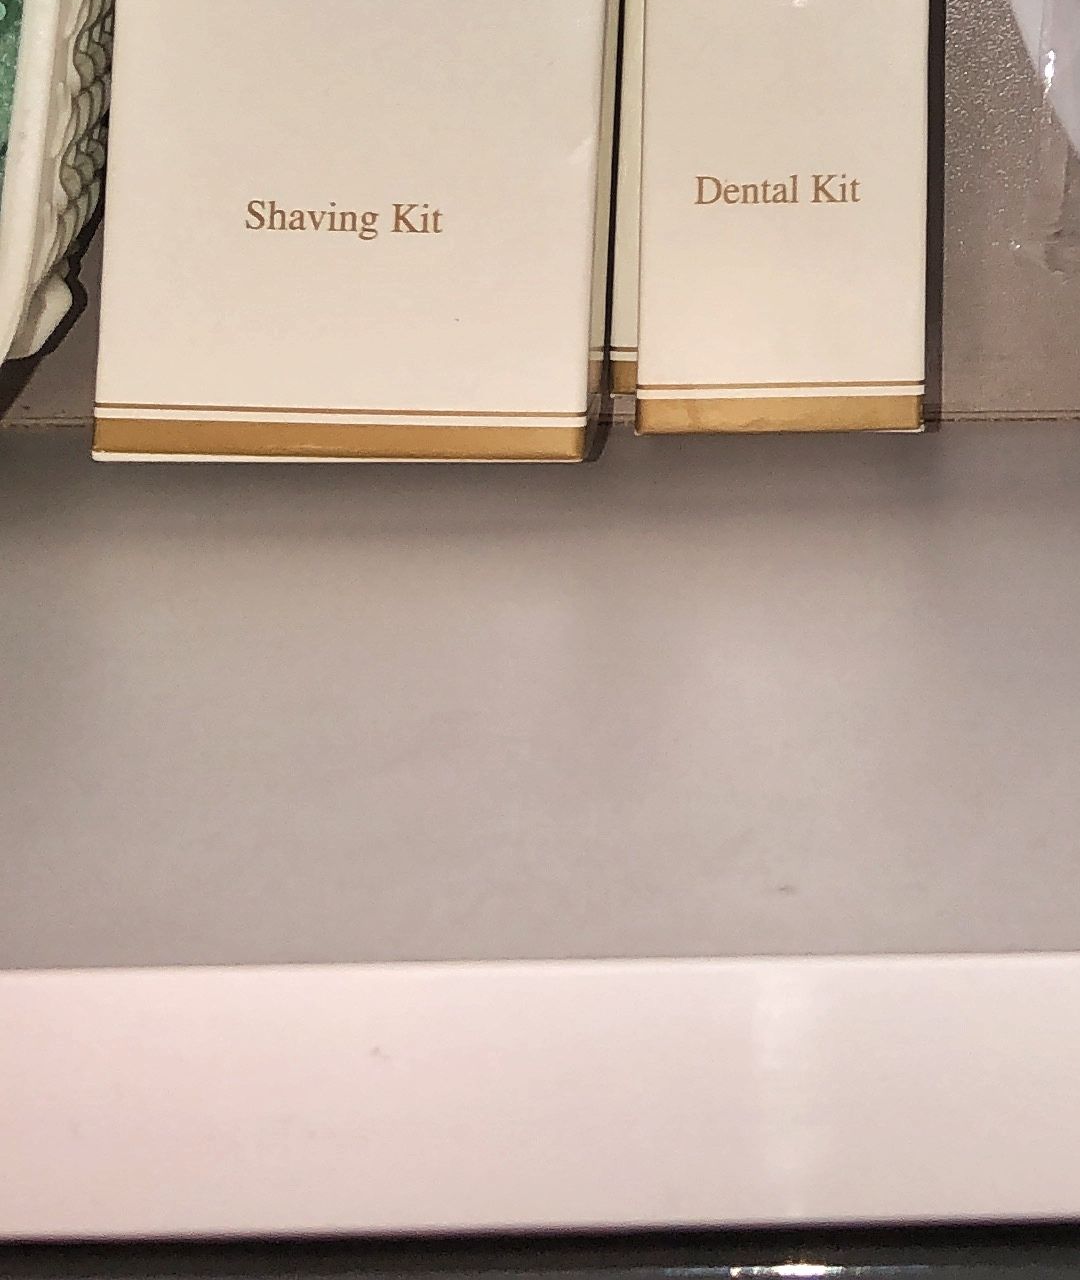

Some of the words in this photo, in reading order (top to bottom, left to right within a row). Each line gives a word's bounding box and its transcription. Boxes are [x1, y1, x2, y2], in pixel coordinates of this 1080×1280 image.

[694, 173, 800, 205] Dental
[810, 173, 861, 204] Kit
[245, 199, 379, 241] Shaving
[391, 203, 444, 234] Kit
